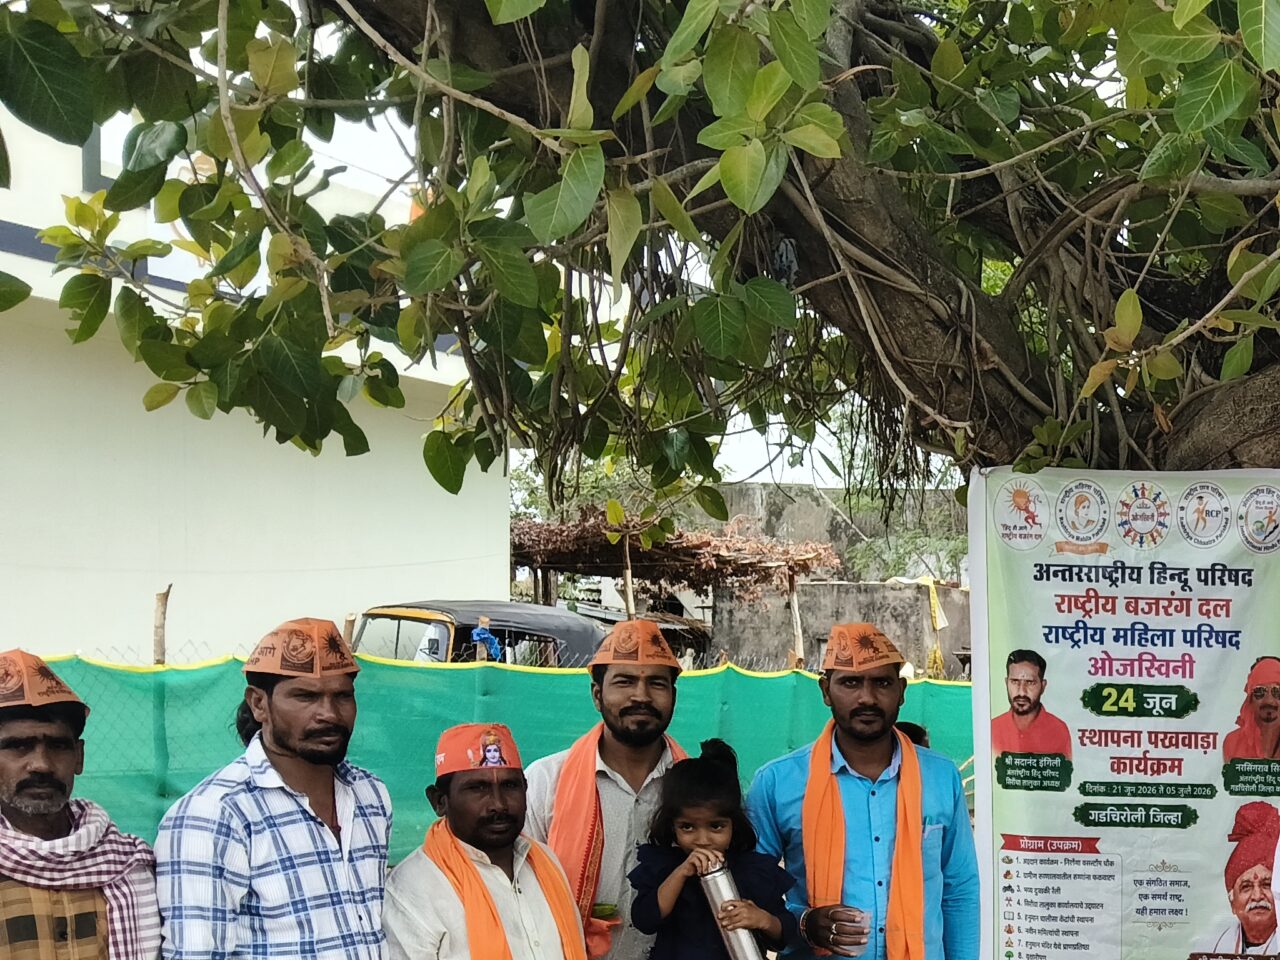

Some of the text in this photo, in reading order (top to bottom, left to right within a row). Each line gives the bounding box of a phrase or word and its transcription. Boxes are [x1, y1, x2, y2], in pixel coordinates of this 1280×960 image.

[1205, 510, 1221, 518] RCP
[1033, 560, 1254, 592] अन्तरराष्ट्रीय हिन्दू परिषद
[1055, 588, 1232, 618] राष्ट्रीय बजरंग दल
[1042, 620, 1242, 650] राष्ट्रीय महिला परिषद
[1088, 650, 1196, 679] ओजस्विनी
[1102, 687, 1178, 715] 24 जून
[1078, 729, 1218, 754] स्थापना पखवाड़ा
[1014, 757, 1036, 767] सदानंद
[1110, 750, 1184, 776] कार्यक्रम
[1086, 784, 1106, 793] दिनांक
[1124, 786, 1135, 795] जून
[1138, 786, 1156, 794] 2026
[1194, 787, 1211, 795] 2026
[1089, 807, 1182, 824] गडचिरोली जिल्हा
[1020, 836, 1082, 851] प्रोग्राम (उपक्रम)
[1146, 877, 1168, 886] संगठित
[1169, 880, 1190, 888] समाज,
[1139, 893, 1150, 901] एक
[1151, 892, 1168, 900] समर्थ
[1136, 906, 1147, 916] यही
[1149, 908, 1166, 916] हमारा
[1168, 908, 1183, 916] लक्ष्य
